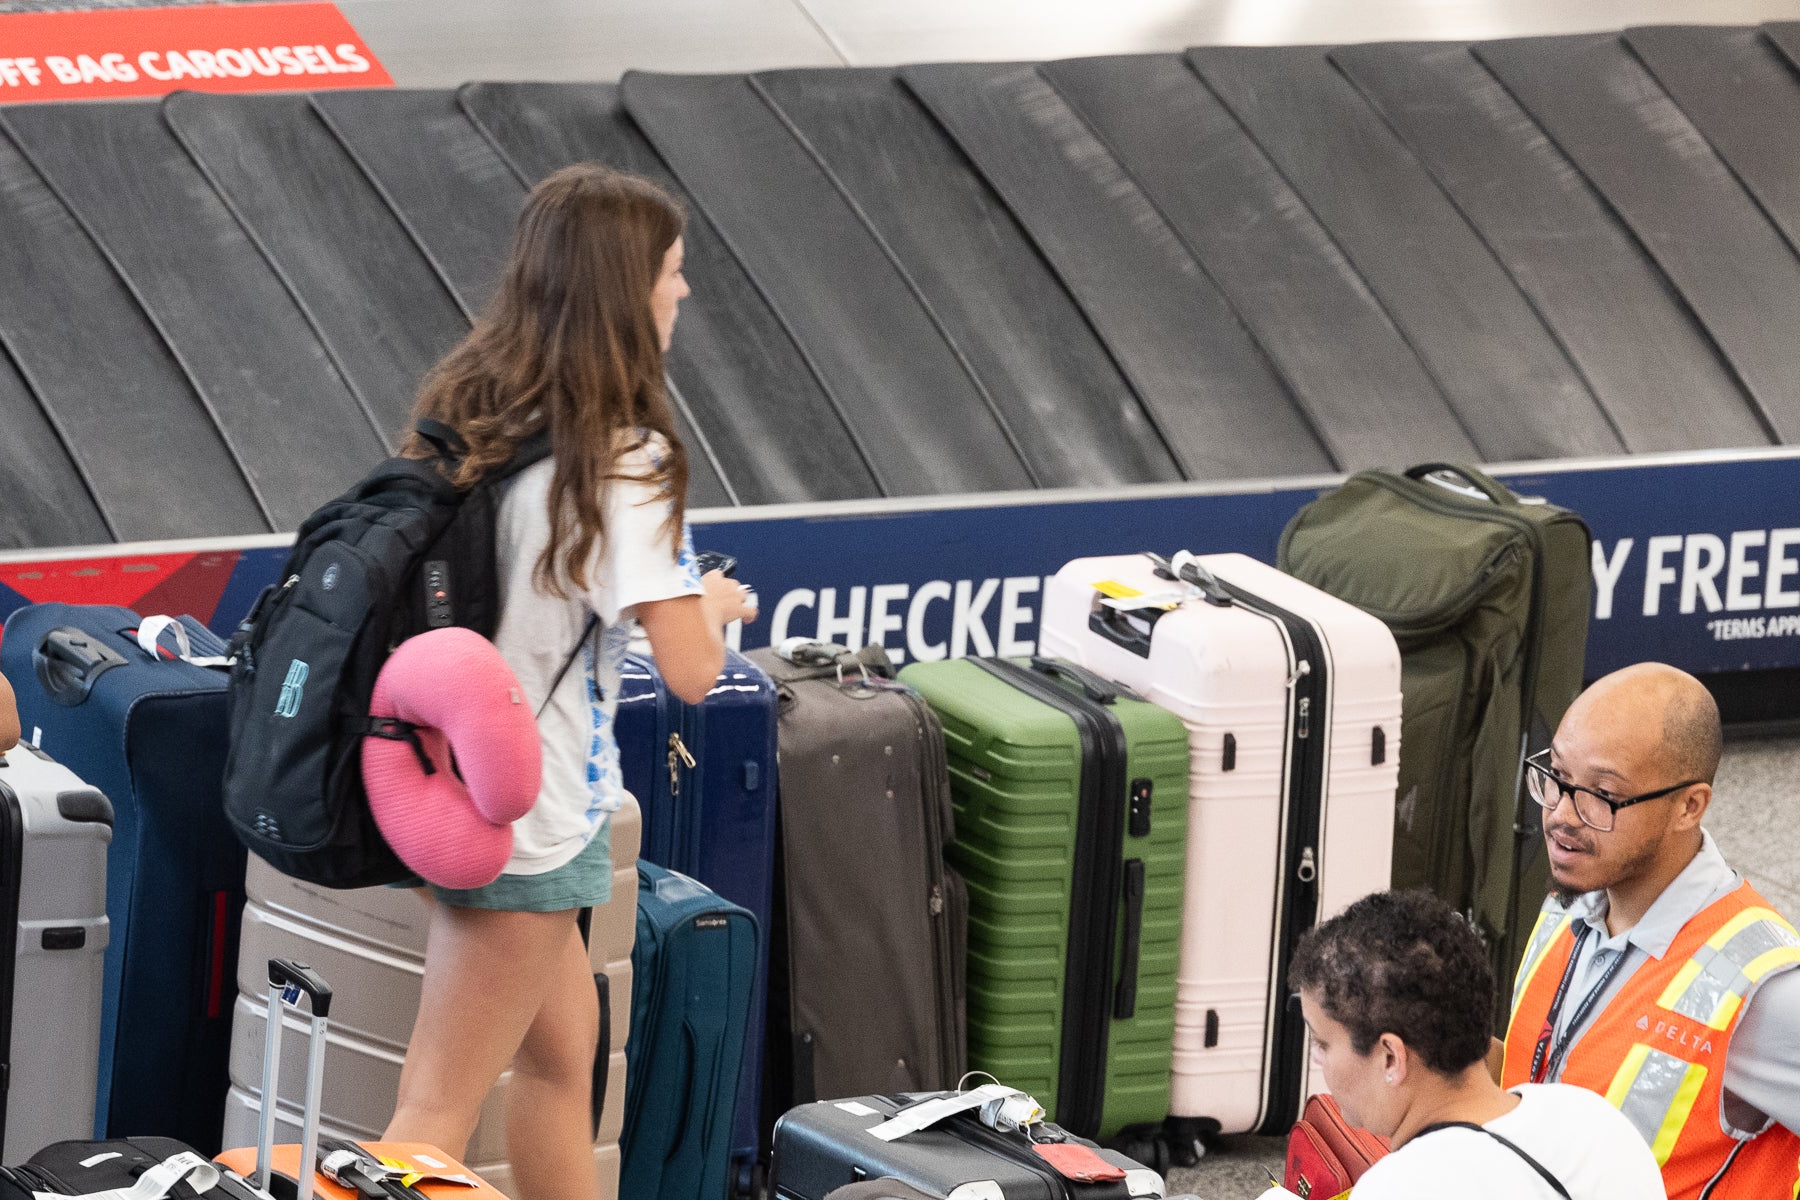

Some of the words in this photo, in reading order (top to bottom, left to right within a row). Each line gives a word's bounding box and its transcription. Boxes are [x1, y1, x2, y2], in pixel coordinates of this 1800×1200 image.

[45, 53, 138, 84] BAG
[138, 43, 370, 80] CAROUSELS
[1643, 528, 1800, 616] FREE
[771, 576, 1053, 663] CHECKE
[1531, 1041, 1545, 1073] DELTA
[1654, 1021, 1712, 1054] DELTA
